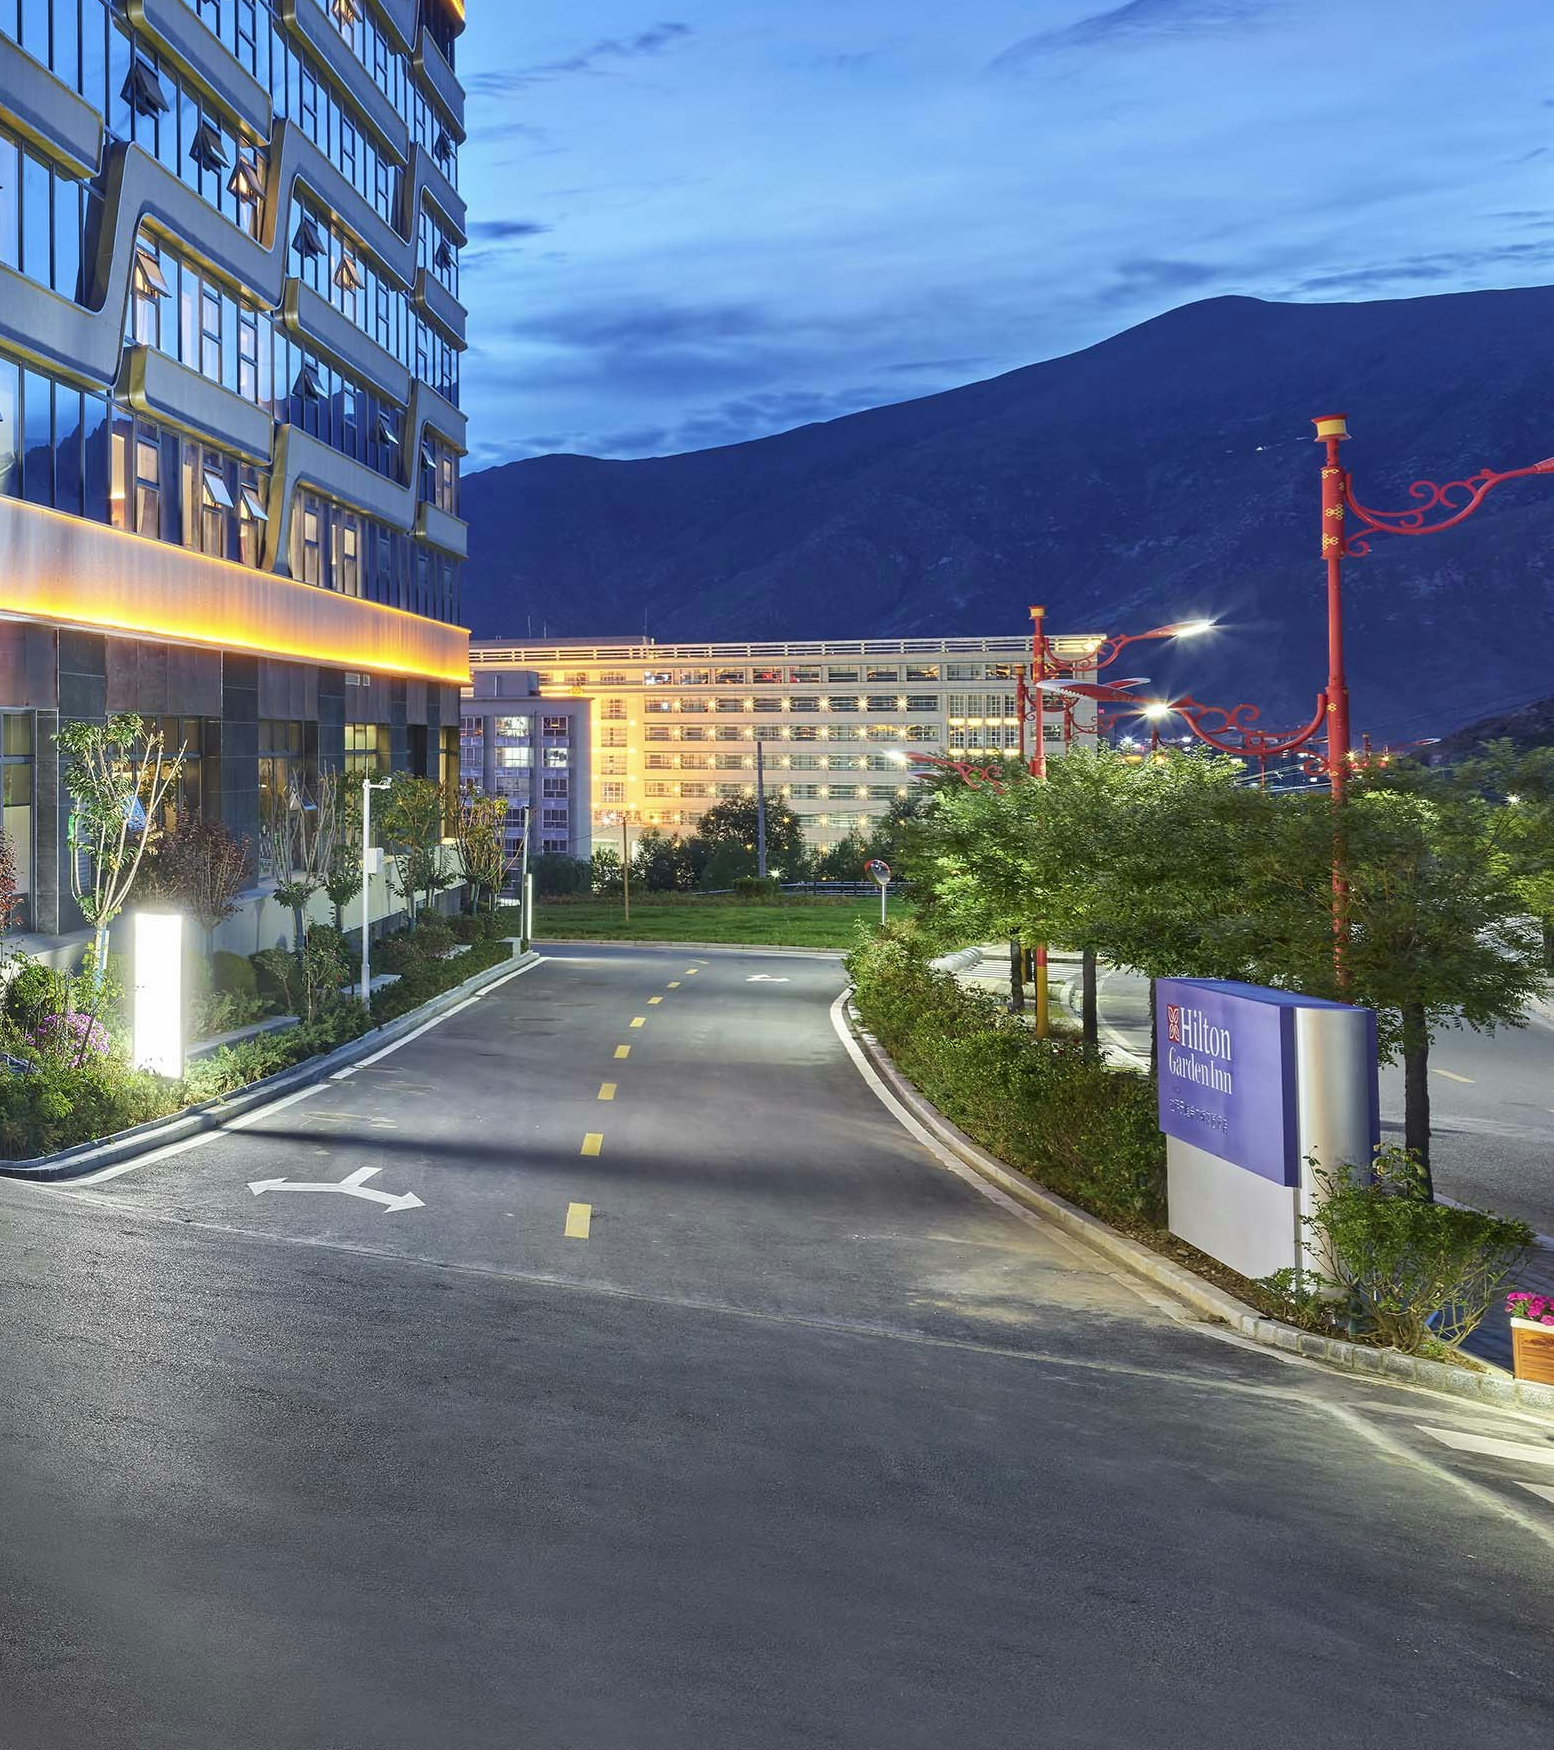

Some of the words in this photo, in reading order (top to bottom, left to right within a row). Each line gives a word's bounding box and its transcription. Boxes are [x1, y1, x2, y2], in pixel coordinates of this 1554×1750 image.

[1180, 1007, 1232, 1061] Hilton
[1169, 1046, 1209, 1087] Garden
[1210, 1060, 1233, 1095] Inn
